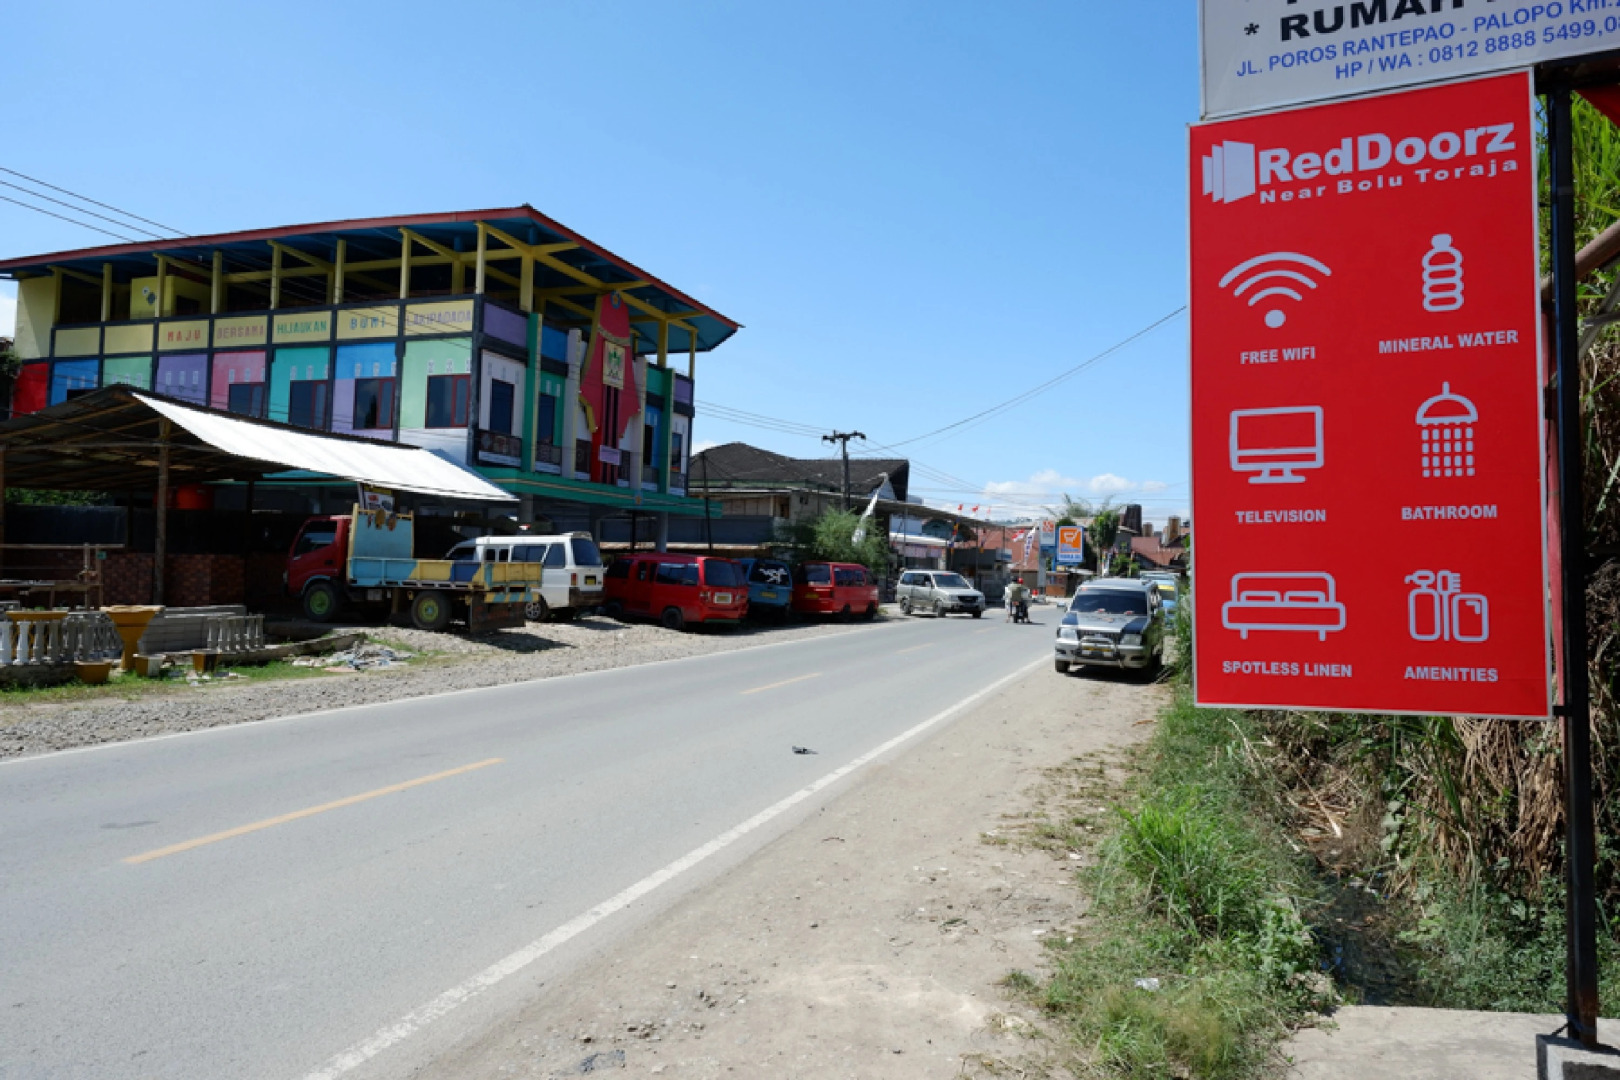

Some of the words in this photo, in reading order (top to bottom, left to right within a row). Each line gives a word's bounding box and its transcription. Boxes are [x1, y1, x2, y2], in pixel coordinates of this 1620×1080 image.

[1237, 60, 1263, 77] JL.
[1268, 44, 1337, 71] POROS
[1342, 22, 1455, 56] RANTEPAO
[1473, 2, 1563, 34] PALOPO
[1335, 61, 1363, 79] HP
[1379, 51, 1413, 71] WA
[1428, 40, 1478, 63] 0812
[1485, 30, 1536, 54] 8888
[1543, 15, 1620, 44] 5499,0
[1258, 122, 1516, 185] RedDoorz
[1260, 179, 1326, 204] Near
[1337, 171, 1402, 194] Bolu
[1414, 159, 1518, 184] Toraja
[167, 329, 202, 342] MAJU
[349, 315, 387, 330] BUMI
[1378, 336, 1454, 354] MINERAL
[1457, 329, 1519, 348] WATER
[1240, 350, 1279, 366] FREE
[1282, 346, 1316, 362] WIFI
[1236, 509, 1327, 524] TELEVISION
[1400, 505, 1498, 521] BATHROOM
[1222, 659, 1300, 677] SPOTLESS
[1304, 662, 1353, 678] LINEN
[1404, 665, 1499, 683] AMENITIES
